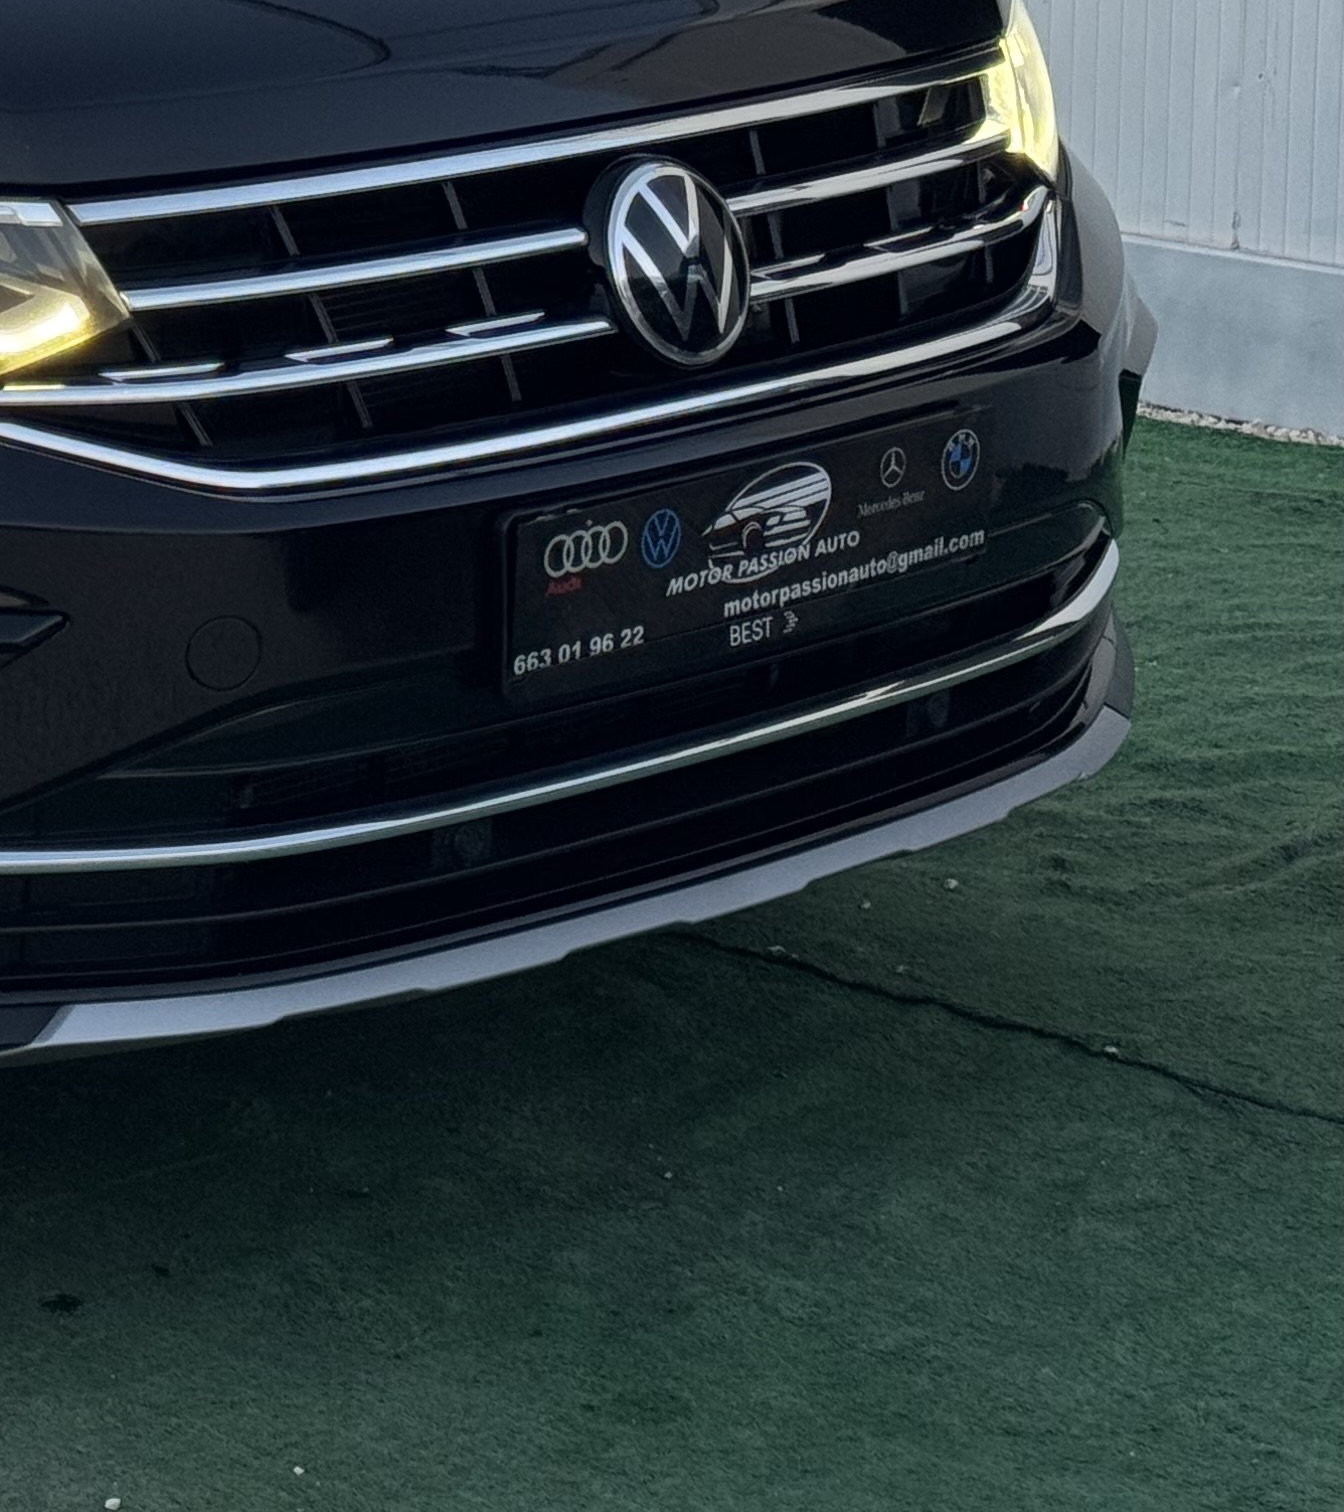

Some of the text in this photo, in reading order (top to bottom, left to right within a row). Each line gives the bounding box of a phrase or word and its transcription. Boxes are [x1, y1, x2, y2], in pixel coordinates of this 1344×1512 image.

[545, 576, 583, 597] Audi
[666, 530, 861, 597] MOTOR PASSION AUTO
[723, 528, 985, 618] motorpassionauto@gmail.com
[513, 625, 645, 675] 663 01 96 22
[729, 616, 774, 647] BEST
